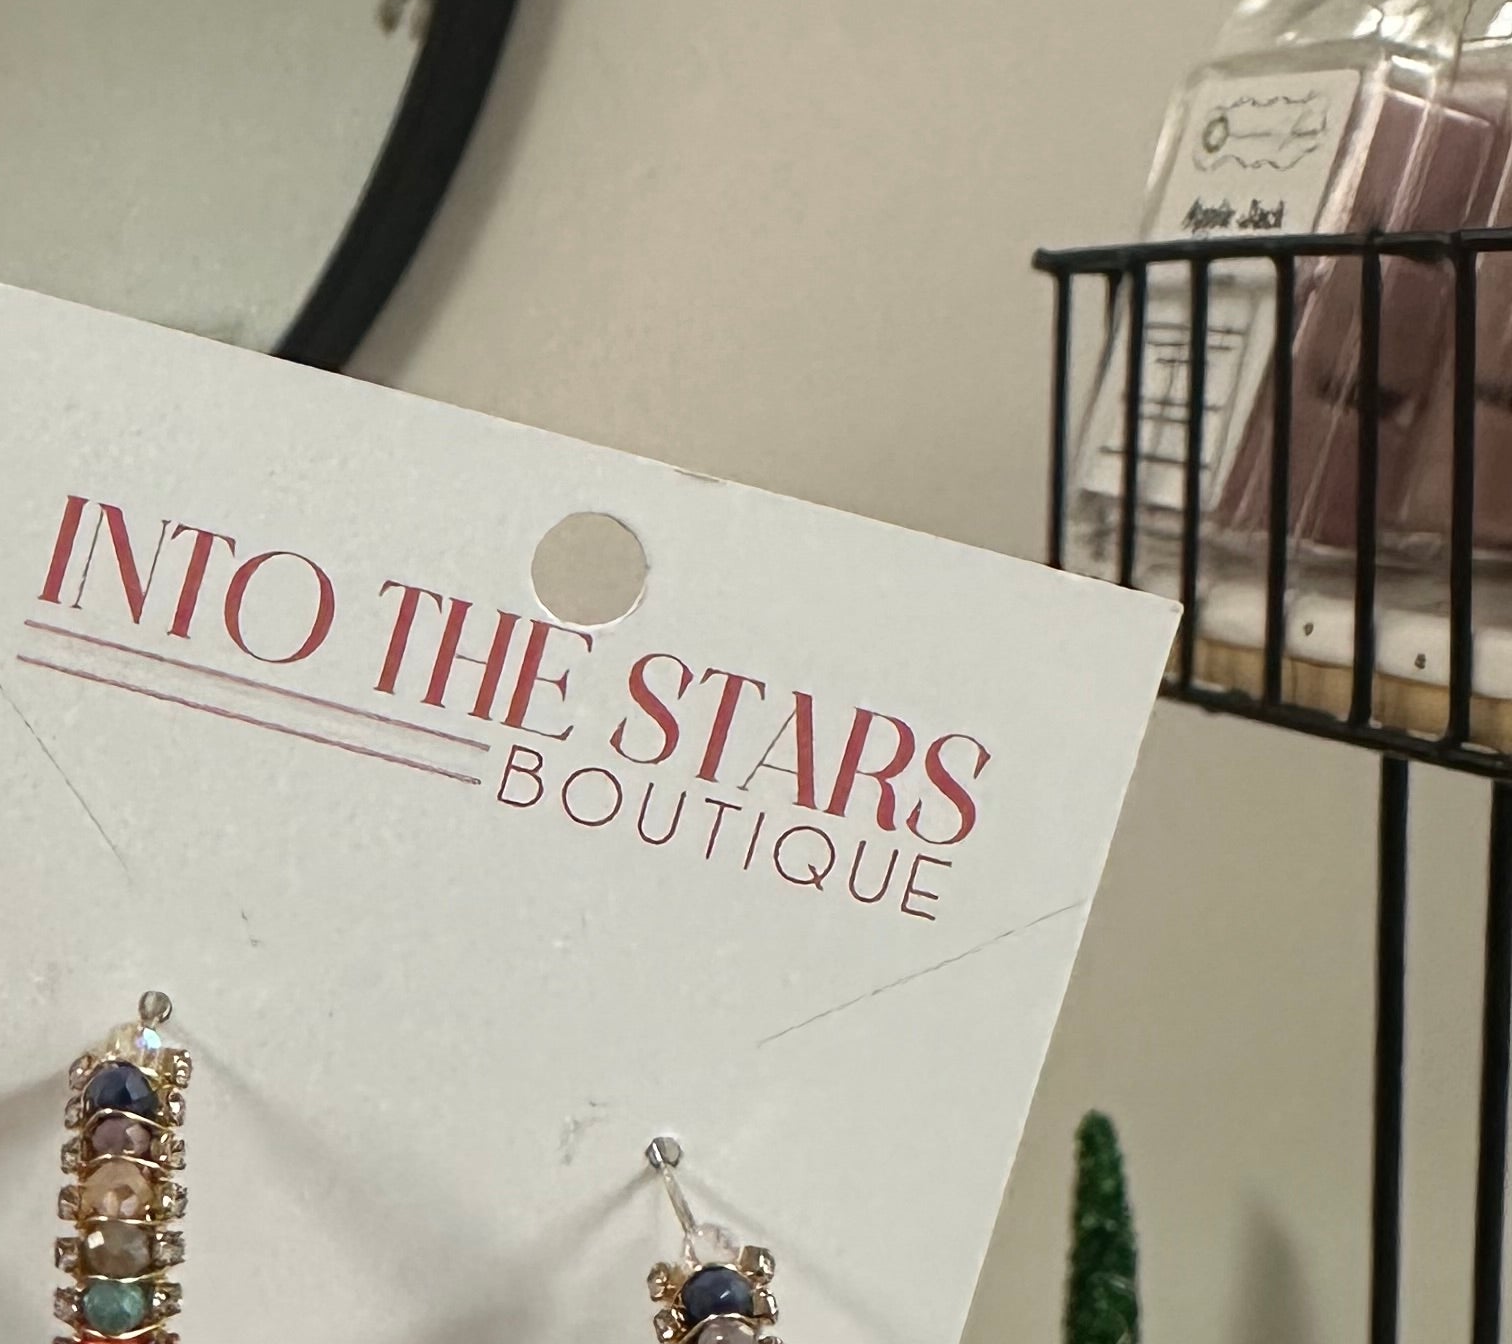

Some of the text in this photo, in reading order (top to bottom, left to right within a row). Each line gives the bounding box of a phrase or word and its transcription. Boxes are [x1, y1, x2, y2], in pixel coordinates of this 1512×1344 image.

[37, 494, 991, 846] INTO THE STARS
[496, 744, 953, 921] BOUTIQUE
